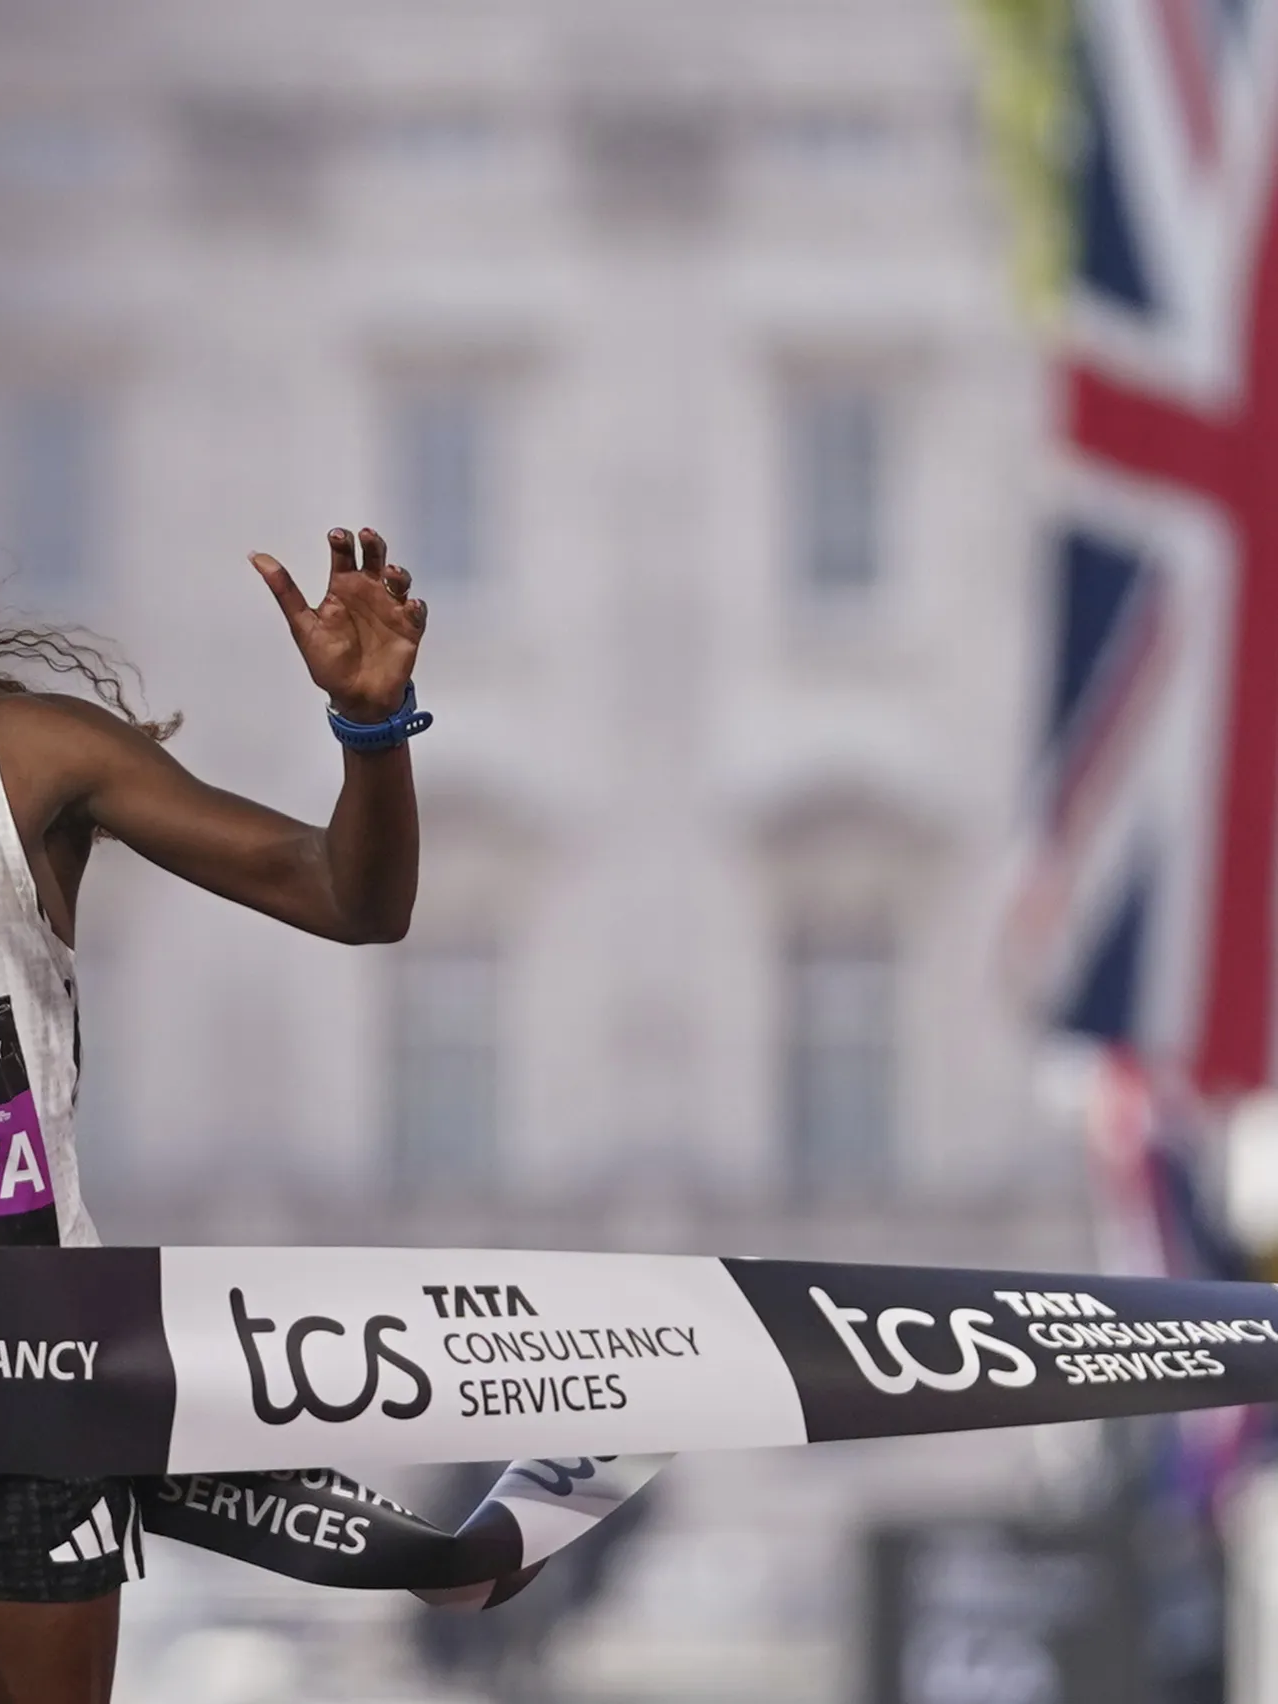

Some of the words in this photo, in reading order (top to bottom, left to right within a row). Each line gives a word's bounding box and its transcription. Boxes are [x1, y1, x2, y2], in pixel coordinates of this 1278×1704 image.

[422, 1285, 539, 1318] TATA
[993, 1291, 1116, 1317] TATA
[443, 1327, 701, 1364] CONSULTANCY
[808, 1286, 1037, 1394] tcs
[1028, 1319, 1278, 1349] CONSULTANCY
[229, 1287, 432, 1425] tcs
[1055, 1350, 1225, 1385] SERVICES
[459, 1374, 627, 1417] SERVICES
[158, 1474, 371, 1555] SERVICES
